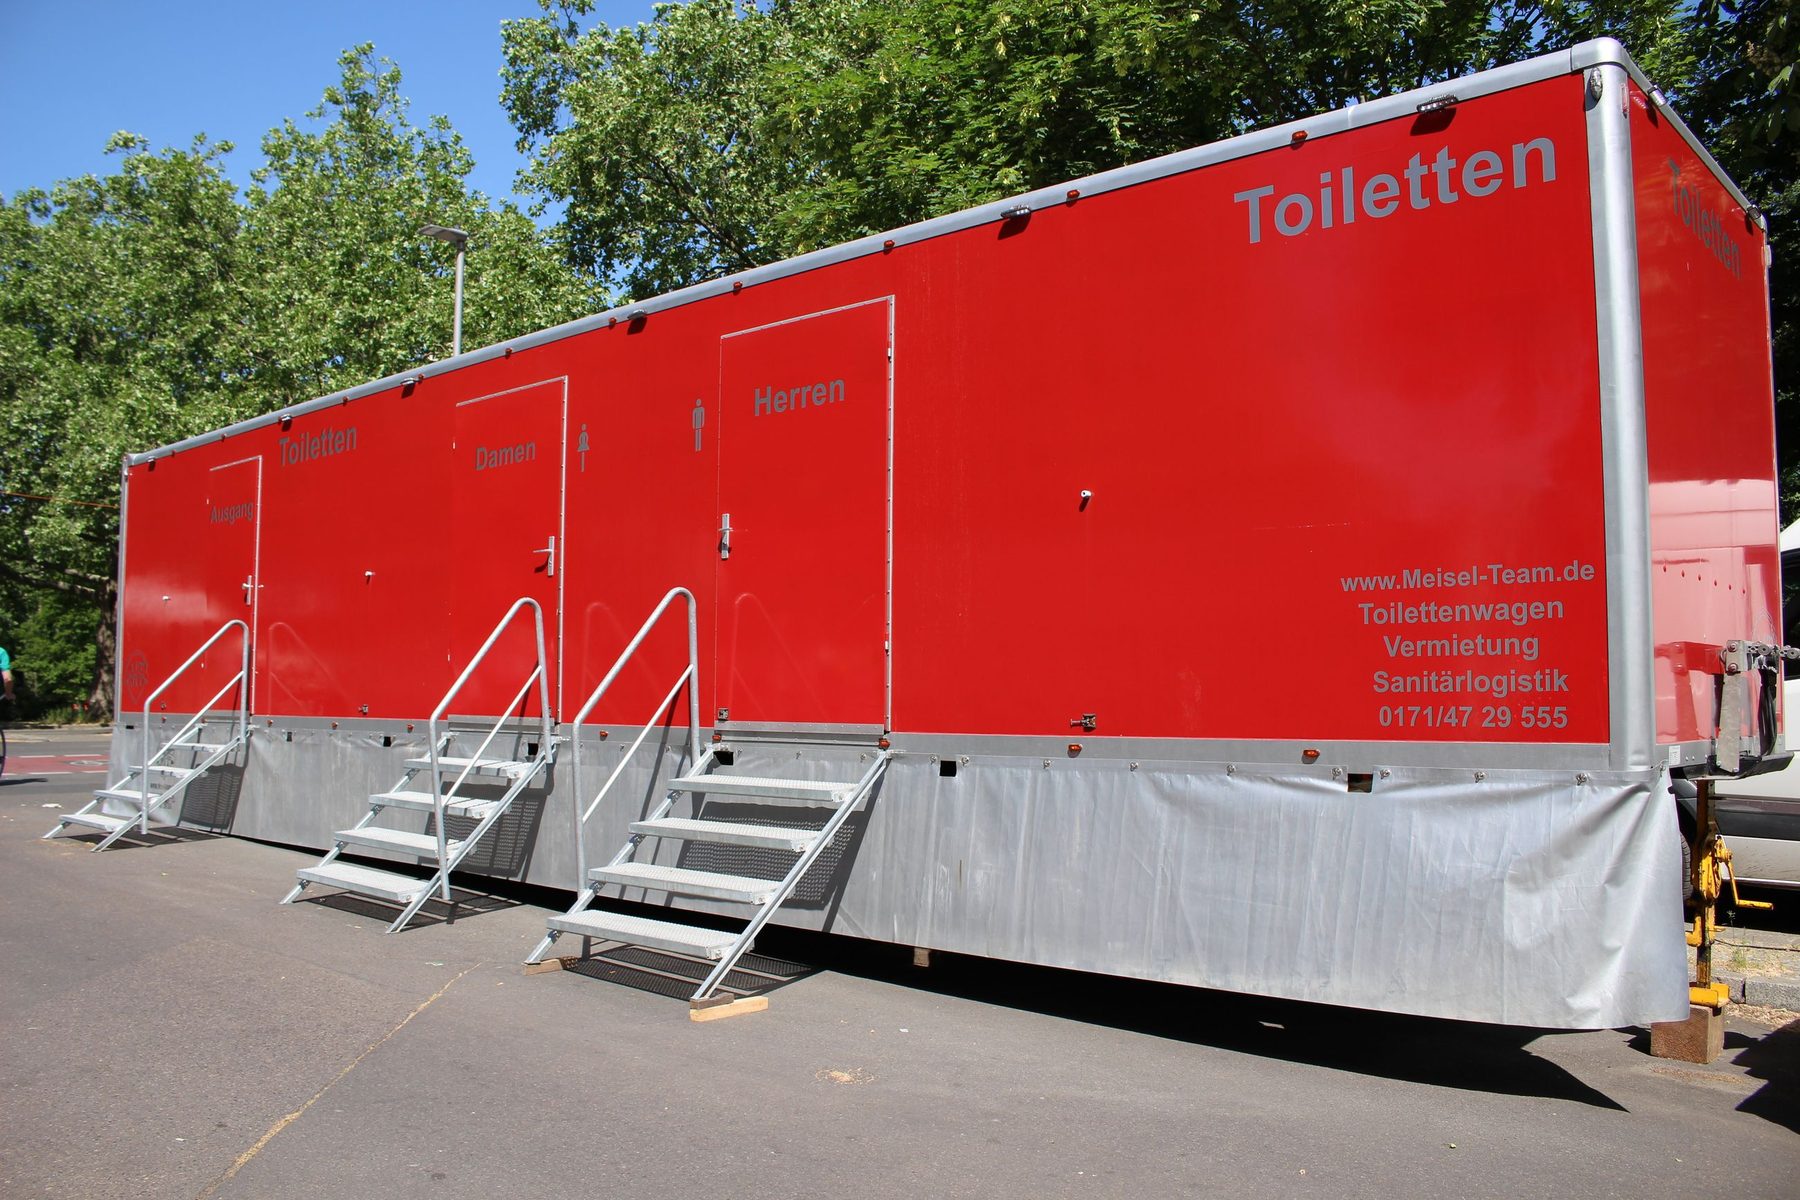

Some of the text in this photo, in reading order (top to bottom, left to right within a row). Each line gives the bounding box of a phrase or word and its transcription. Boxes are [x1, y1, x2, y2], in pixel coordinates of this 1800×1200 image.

[1233, 136, 1557, 244] Toiletten
[1668, 158, 1742, 278] Toiletten
[754, 378, 845, 416] Herren
[278, 426, 358, 466] Toiletten
[476, 441, 536, 471] Damen
[210, 500, 254, 526] Ausgang
[1341, 560, 1595, 592] www.Meisel-Team.de
[1358, 598, 1564, 626] Toilettenwagen
[1383, 633, 1540, 661] Vermietung
[1373, 669, 1569, 698] Sanitärlogistik
[1379, 705, 1569, 729] 0171/47 29 555
